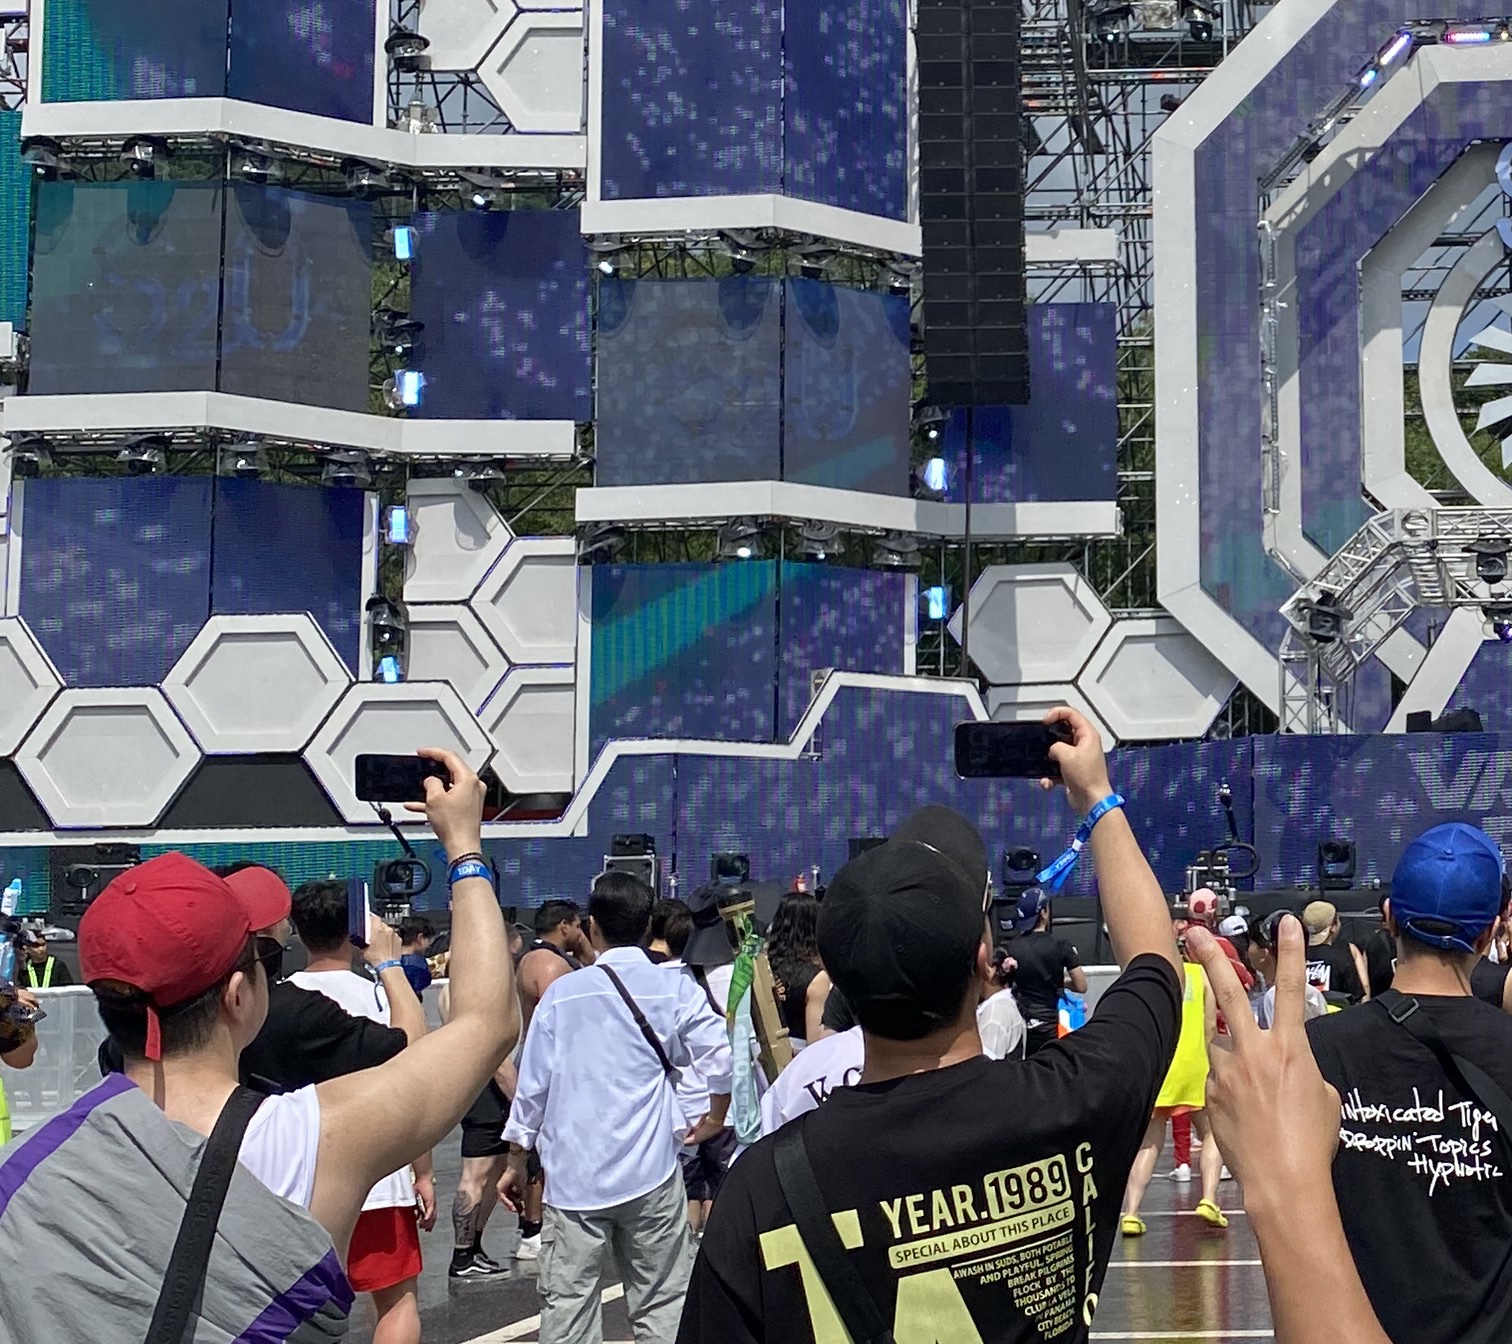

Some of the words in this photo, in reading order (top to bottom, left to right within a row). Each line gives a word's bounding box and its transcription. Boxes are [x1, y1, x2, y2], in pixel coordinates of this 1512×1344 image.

[895, 1241, 950, 1264] SPECIAL
[952, 1231, 997, 1251] ABOUT
[999, 1220, 1030, 1239] THIS
[1031, 1206, 1070, 1228] PLACE
[953, 1263, 984, 1279] AWASH
[985, 1262, 995, 1272] IN
[1020, 1249, 1042, 1262] BOTH
[1042, 1234, 1074, 1254] POTABLE
[980, 1270, 1001, 1285] AND
[1045, 1244, 1074, 1263] SPRING
[1007, 1270, 1037, 1288] BREAK
[1037, 1253, 1075, 1276] PILGRIMS
[1013, 1281, 1041, 1298] FLOCK
[1046, 1274, 1057, 1285] BY
[1061, 1264, 1075, 1278] THE
[1014, 1281, 1066, 1308] THOUSANDS
